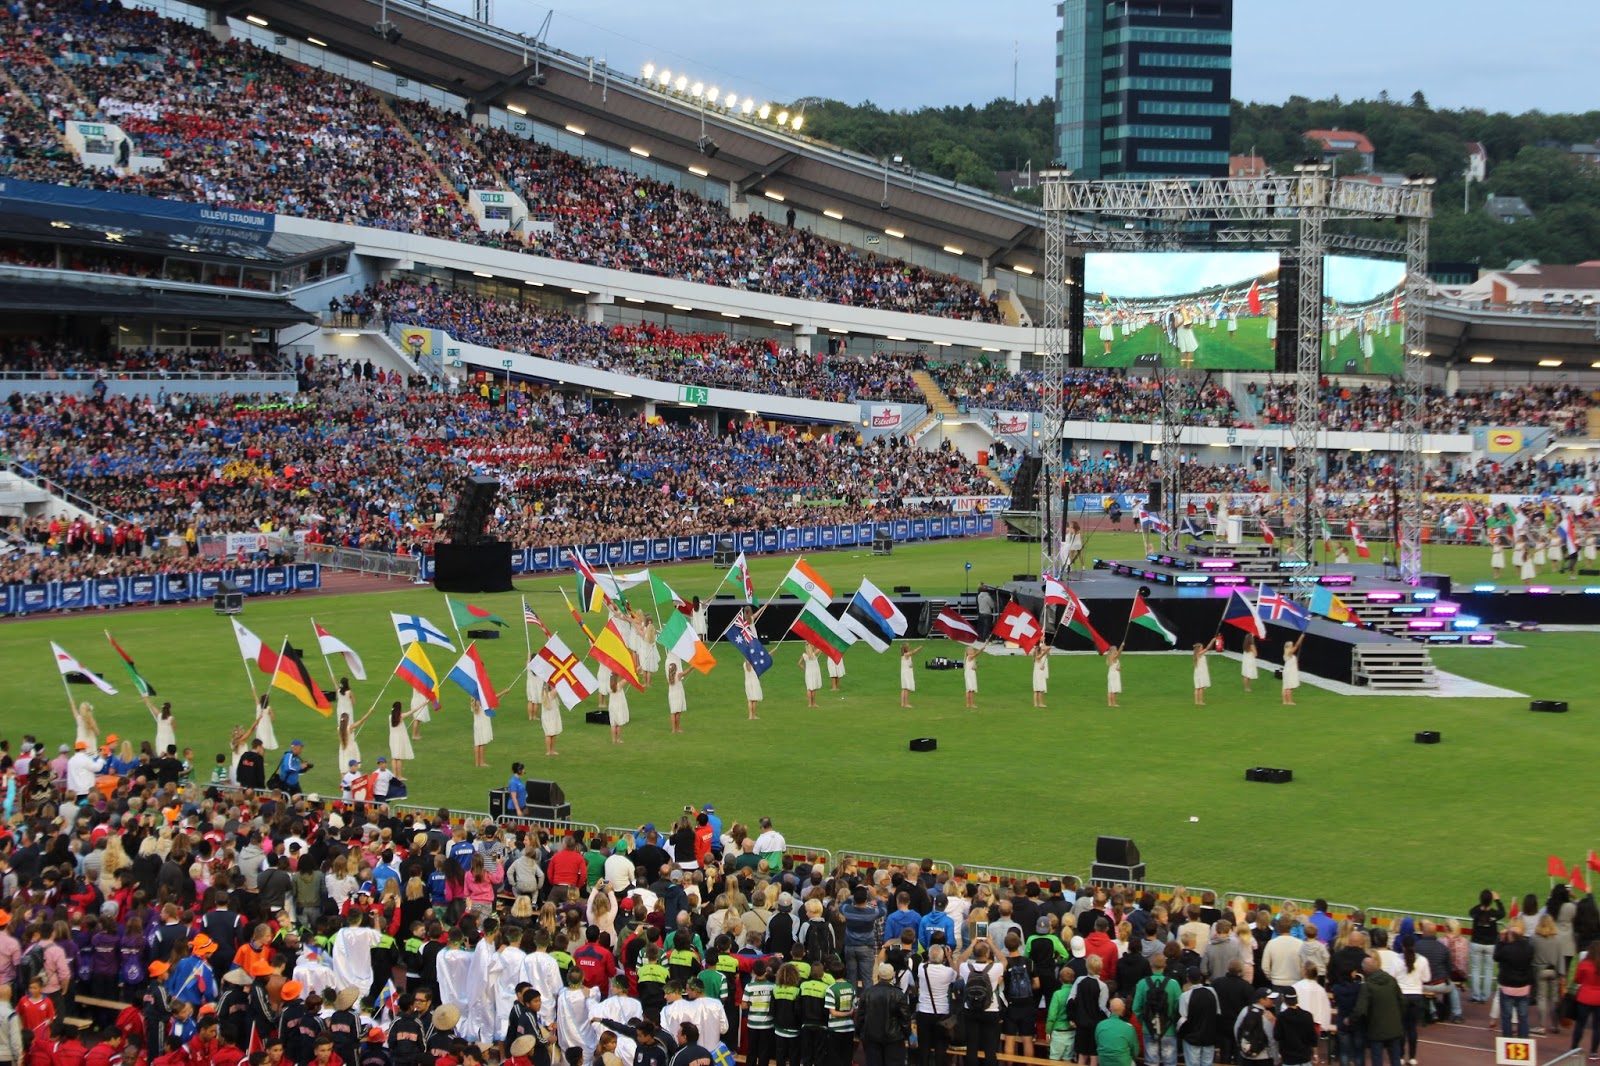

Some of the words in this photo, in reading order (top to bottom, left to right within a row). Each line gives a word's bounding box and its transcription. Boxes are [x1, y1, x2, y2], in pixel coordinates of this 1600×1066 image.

[200, 209, 227, 220] ULLEVI
[229, 213, 265, 226] STADIUM
[873, 417, 898, 426] Estrella
[1001, 423, 1025, 433] Estrella
[957, 498, 1011, 509] INTERSPO
[1507, 1043, 1527, 1060] 13
